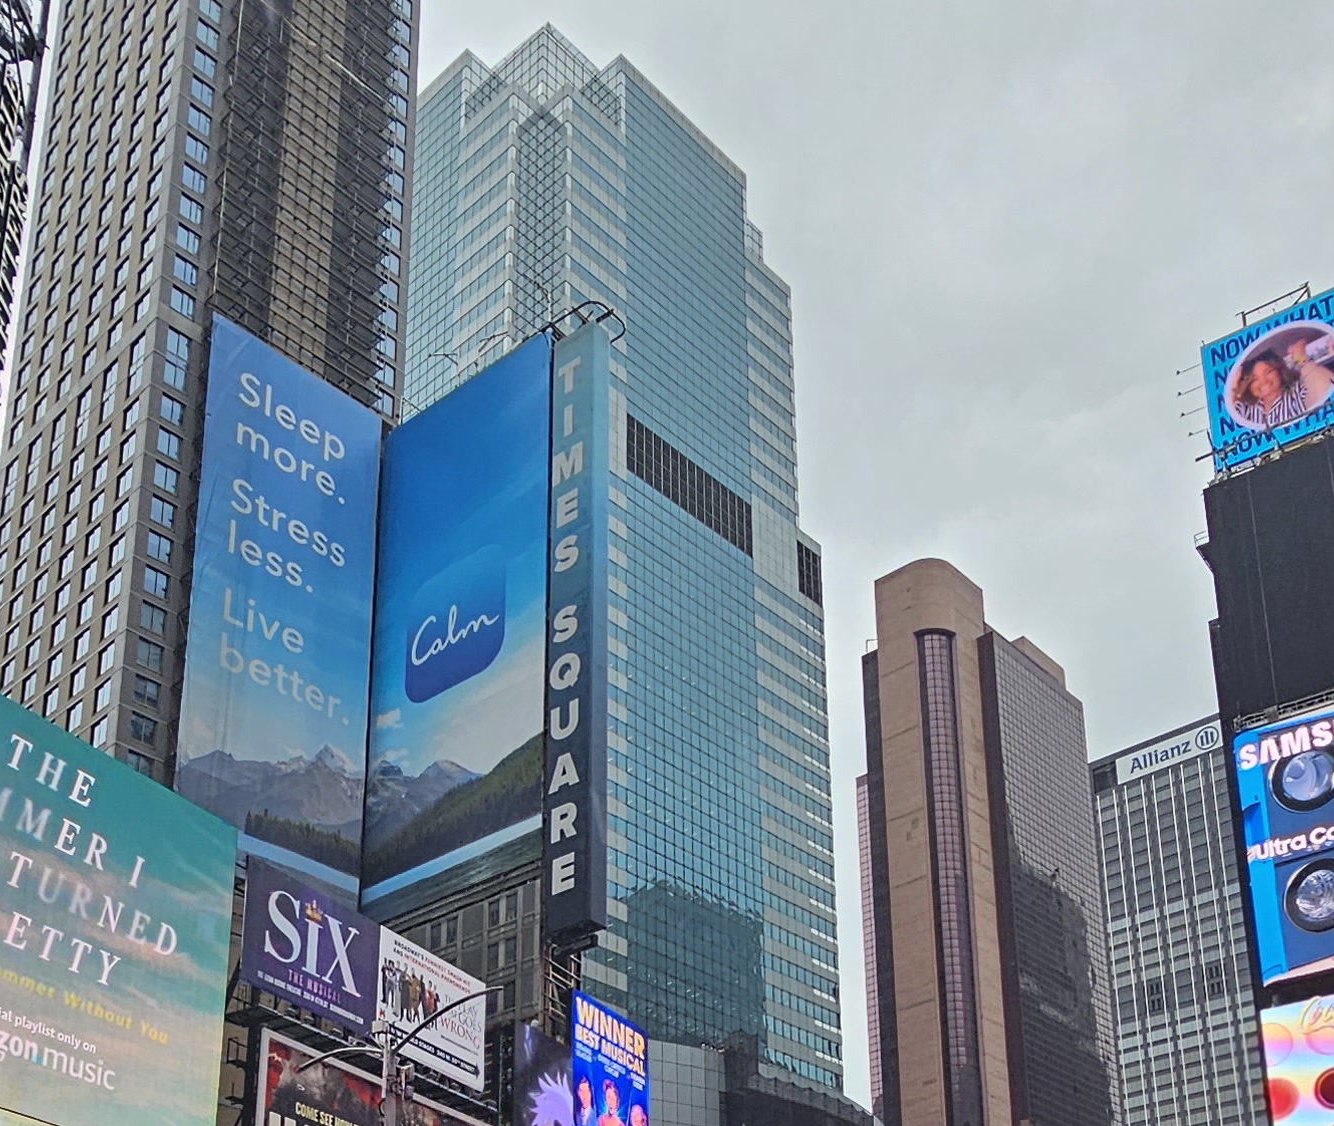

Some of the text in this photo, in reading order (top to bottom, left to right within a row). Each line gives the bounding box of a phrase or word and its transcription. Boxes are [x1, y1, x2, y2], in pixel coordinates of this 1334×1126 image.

[1210, 332, 1261, 368] NOW
[238, 371, 346, 461] Sleep
[235, 423, 346, 506] more.
[229, 478, 346, 569] Stress
[227, 520, 314, 594] less.
[222, 587, 305, 655] Live
[410, 603, 500, 668] Calm
[549, 356, 585, 897] TIMES SQUARE
[218, 632, 350, 727] better.
[8, 732, 97, 809] THE
[1129, 739, 1192, 775] Allianz
[126, 854, 148, 889] I
[1254, 831, 1308, 861] Ultra
[4, 852, 179, 958] TURNED
[264, 889, 362, 999] SIX
[63, 988, 134, 1033] Without
[140, 1015, 170, 1045] You
[288, 968, 304, 987] THE
[306, 977, 342, 1005] MUSICAL
[14, 1008, 56, 1042] playlist
[57, 1020, 82, 1049] only
[83, 1037, 97, 1054] on
[440, 1016, 481, 1050] WRONG
[574, 1023, 601, 1051] BEST
[601, 1038, 646, 1077] MUSICAL
[576, 996, 646, 1059] WINNER
[41, 1041, 117, 1092] music
[295, 1101, 319, 1123] COME
